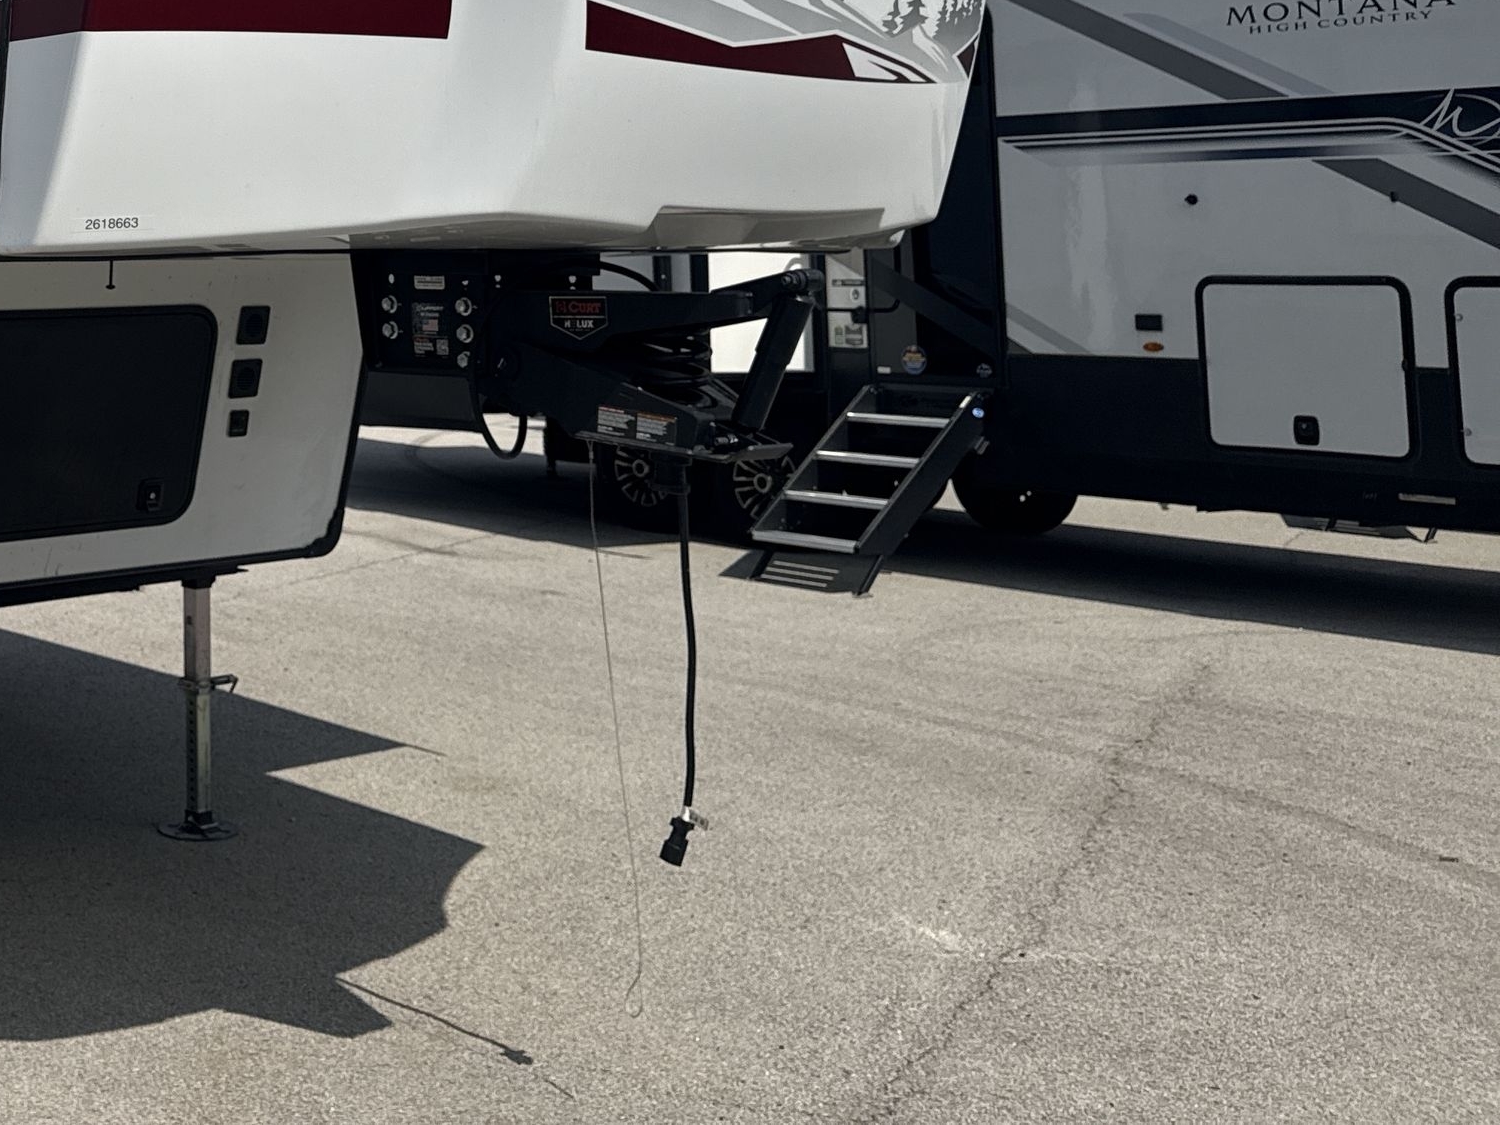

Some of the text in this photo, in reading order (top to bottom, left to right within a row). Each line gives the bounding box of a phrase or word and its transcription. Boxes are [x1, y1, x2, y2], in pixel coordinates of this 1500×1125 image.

[1249, 10, 1432, 35] HIGH COUNTRY
[85, 217, 139, 230] 2618663
